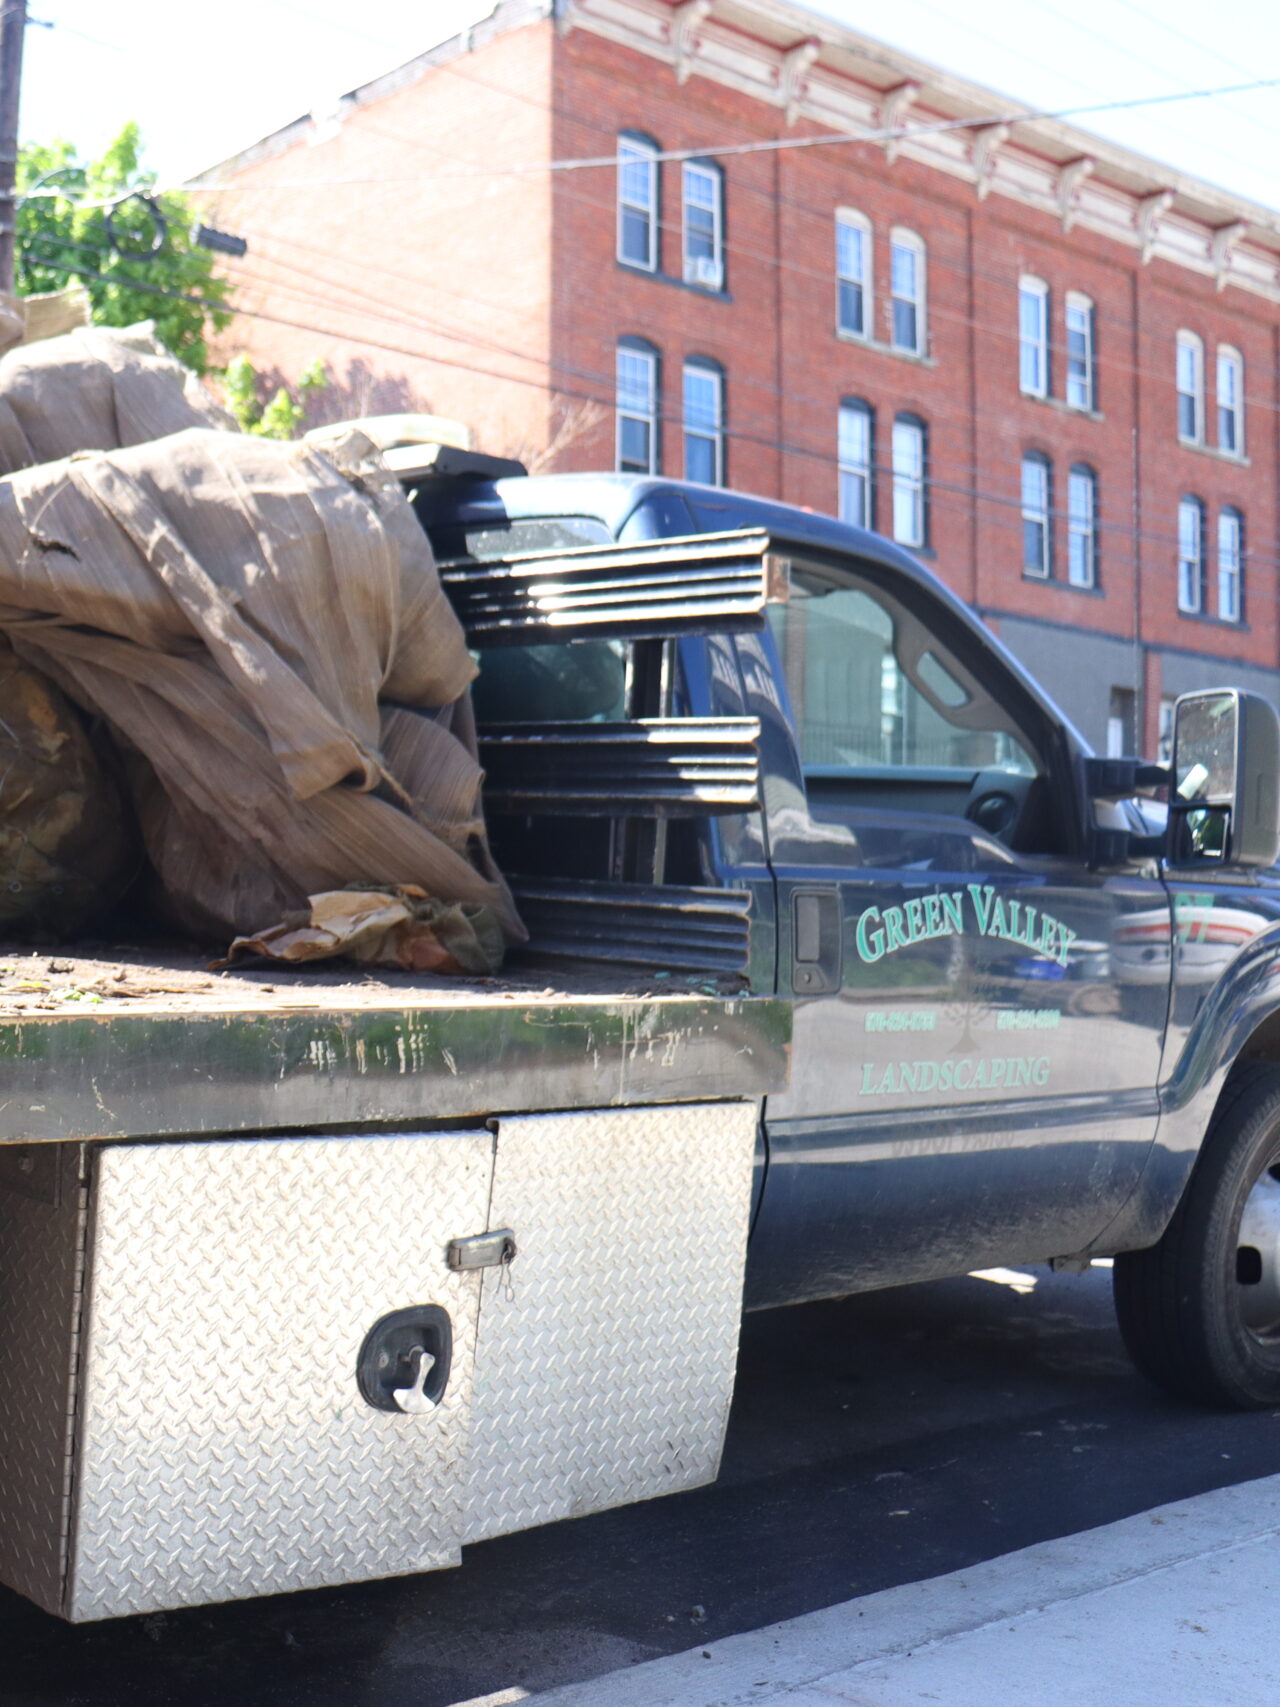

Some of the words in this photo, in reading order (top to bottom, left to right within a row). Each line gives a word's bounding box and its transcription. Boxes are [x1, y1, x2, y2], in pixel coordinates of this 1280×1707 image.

[856, 891, 964, 963] GREEN
[967, 883, 1077, 969] VALLEY
[859, 1056, 1052, 1095] LANDSCAPING
